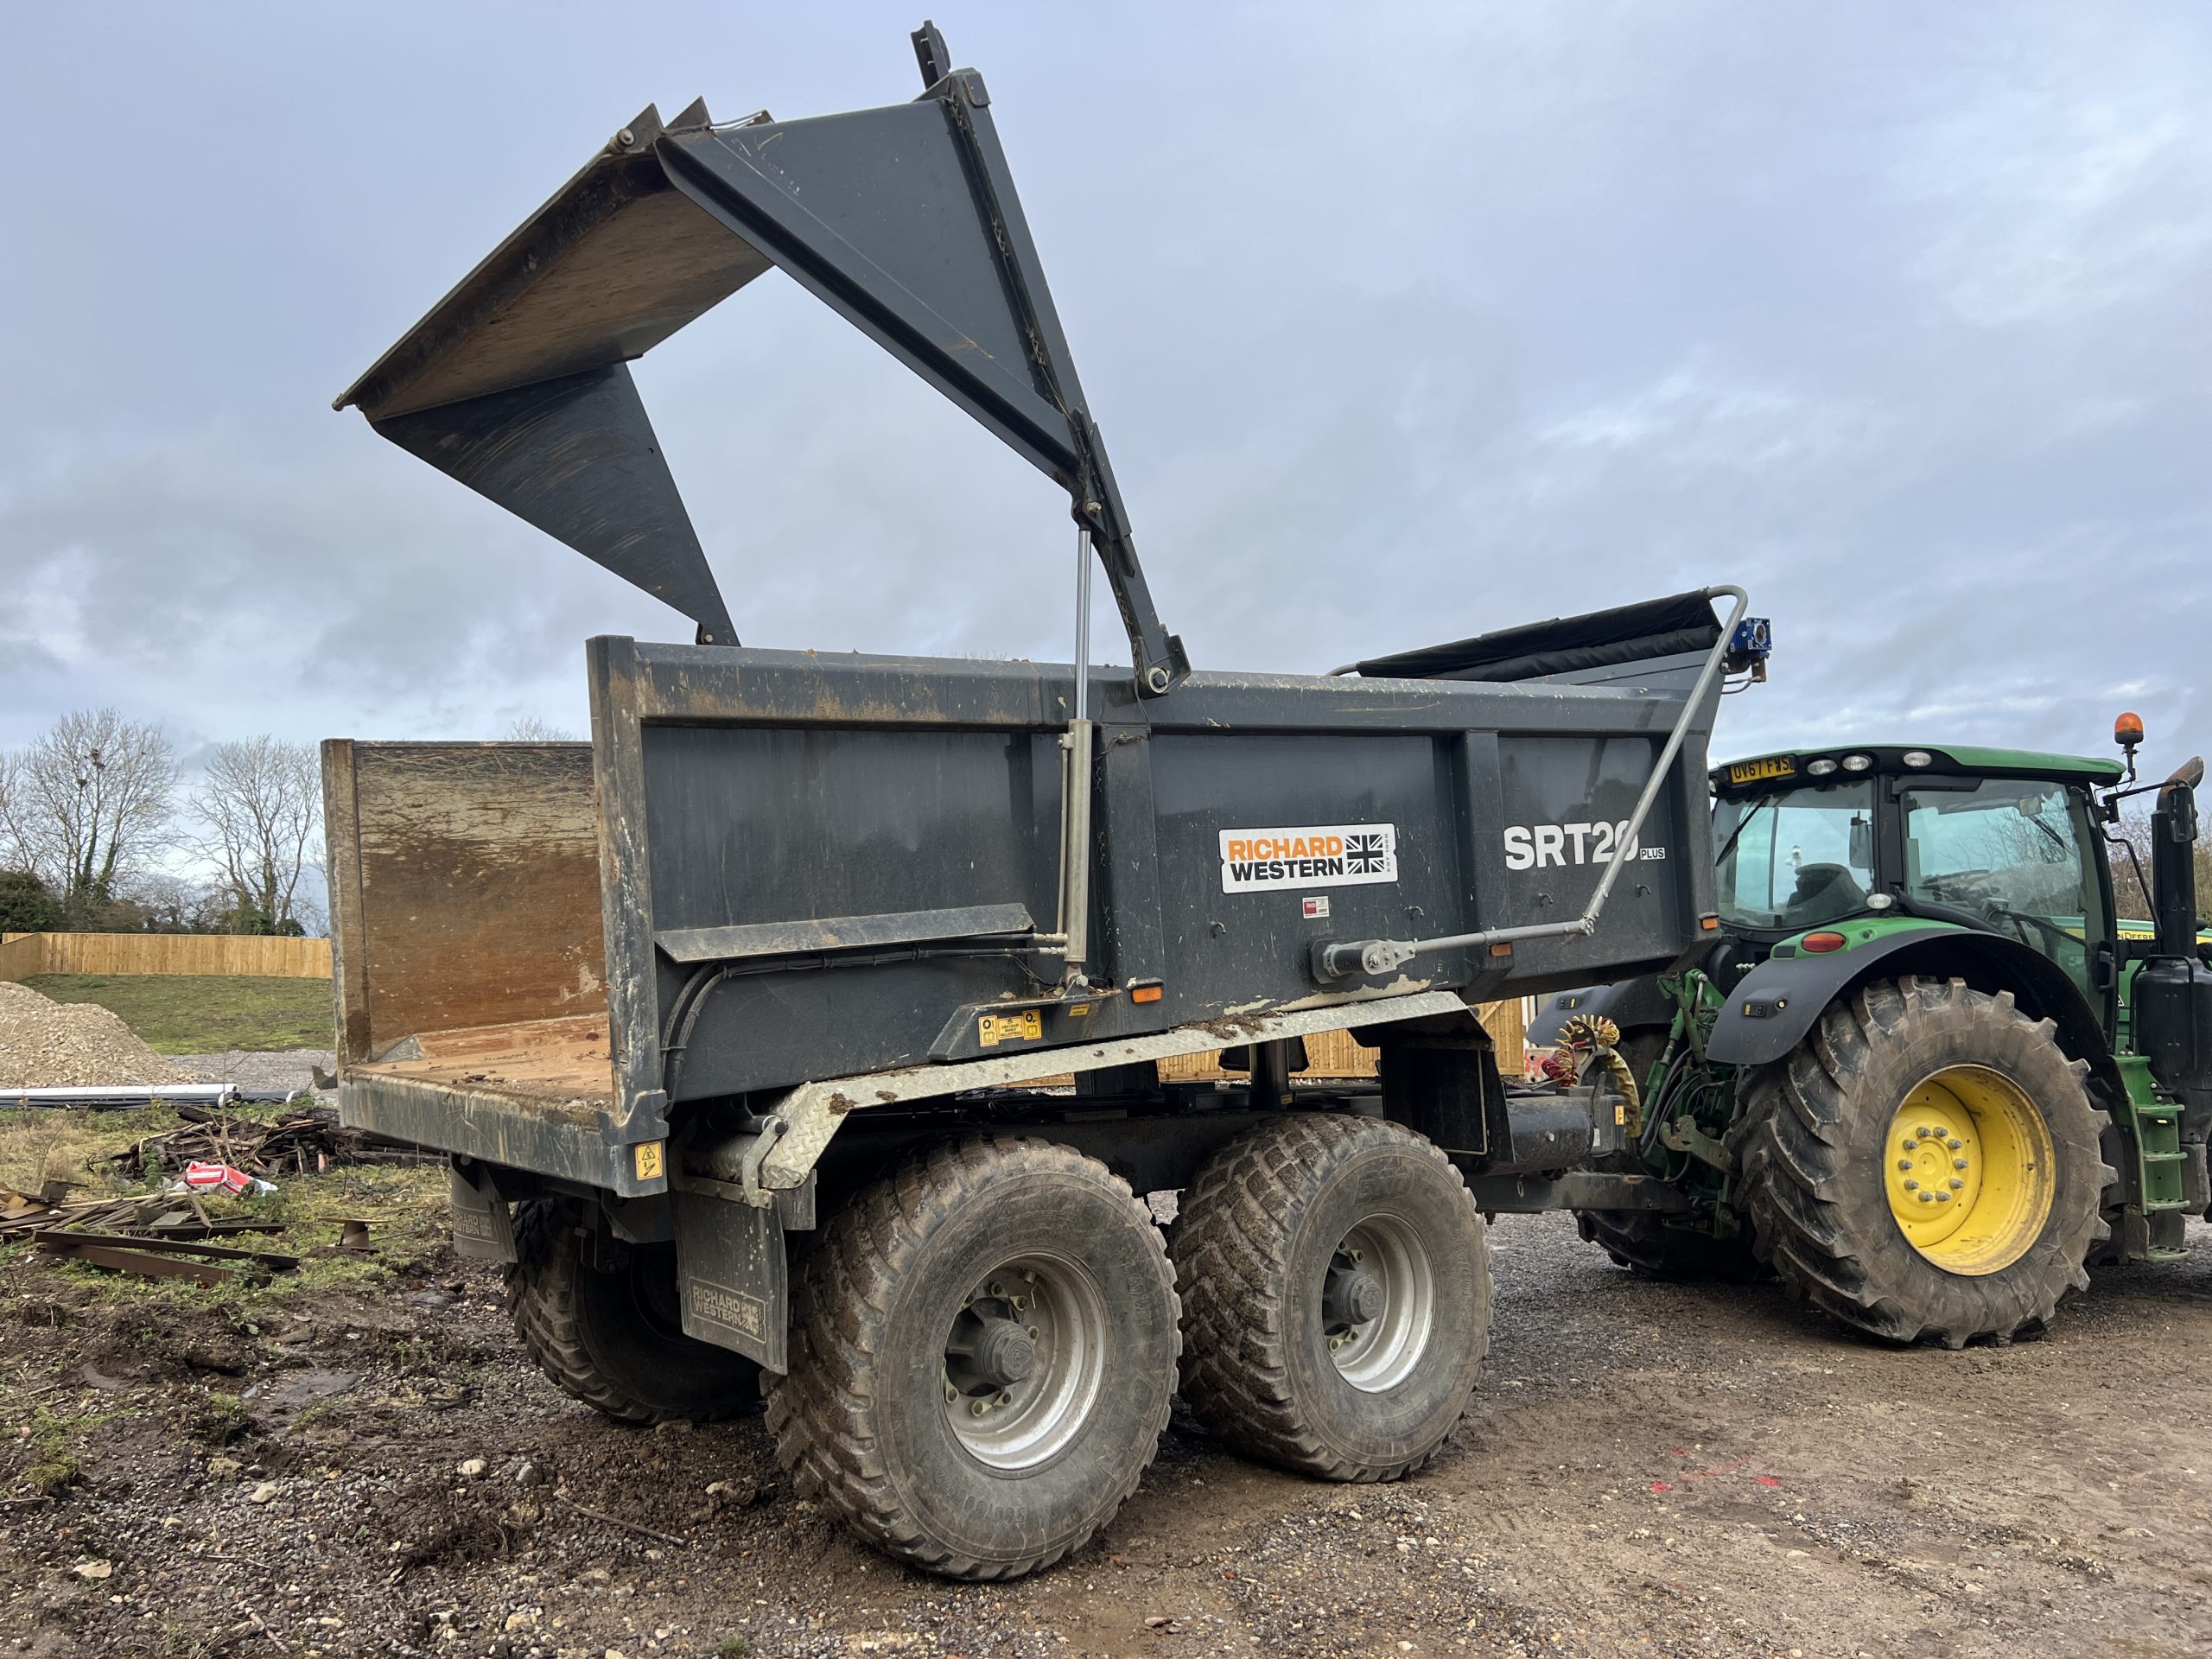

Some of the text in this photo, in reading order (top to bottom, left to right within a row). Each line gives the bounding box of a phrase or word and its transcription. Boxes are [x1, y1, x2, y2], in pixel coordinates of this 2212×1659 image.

[1228, 836, 1343, 861] RICHARD
[1503, 820, 1664, 870] SRT20 PLUS
[1230, 858, 1344, 881] WESTERN
[692, 1286, 741, 1313] RICHARD
[694, 1297, 743, 1326] WESTERN
